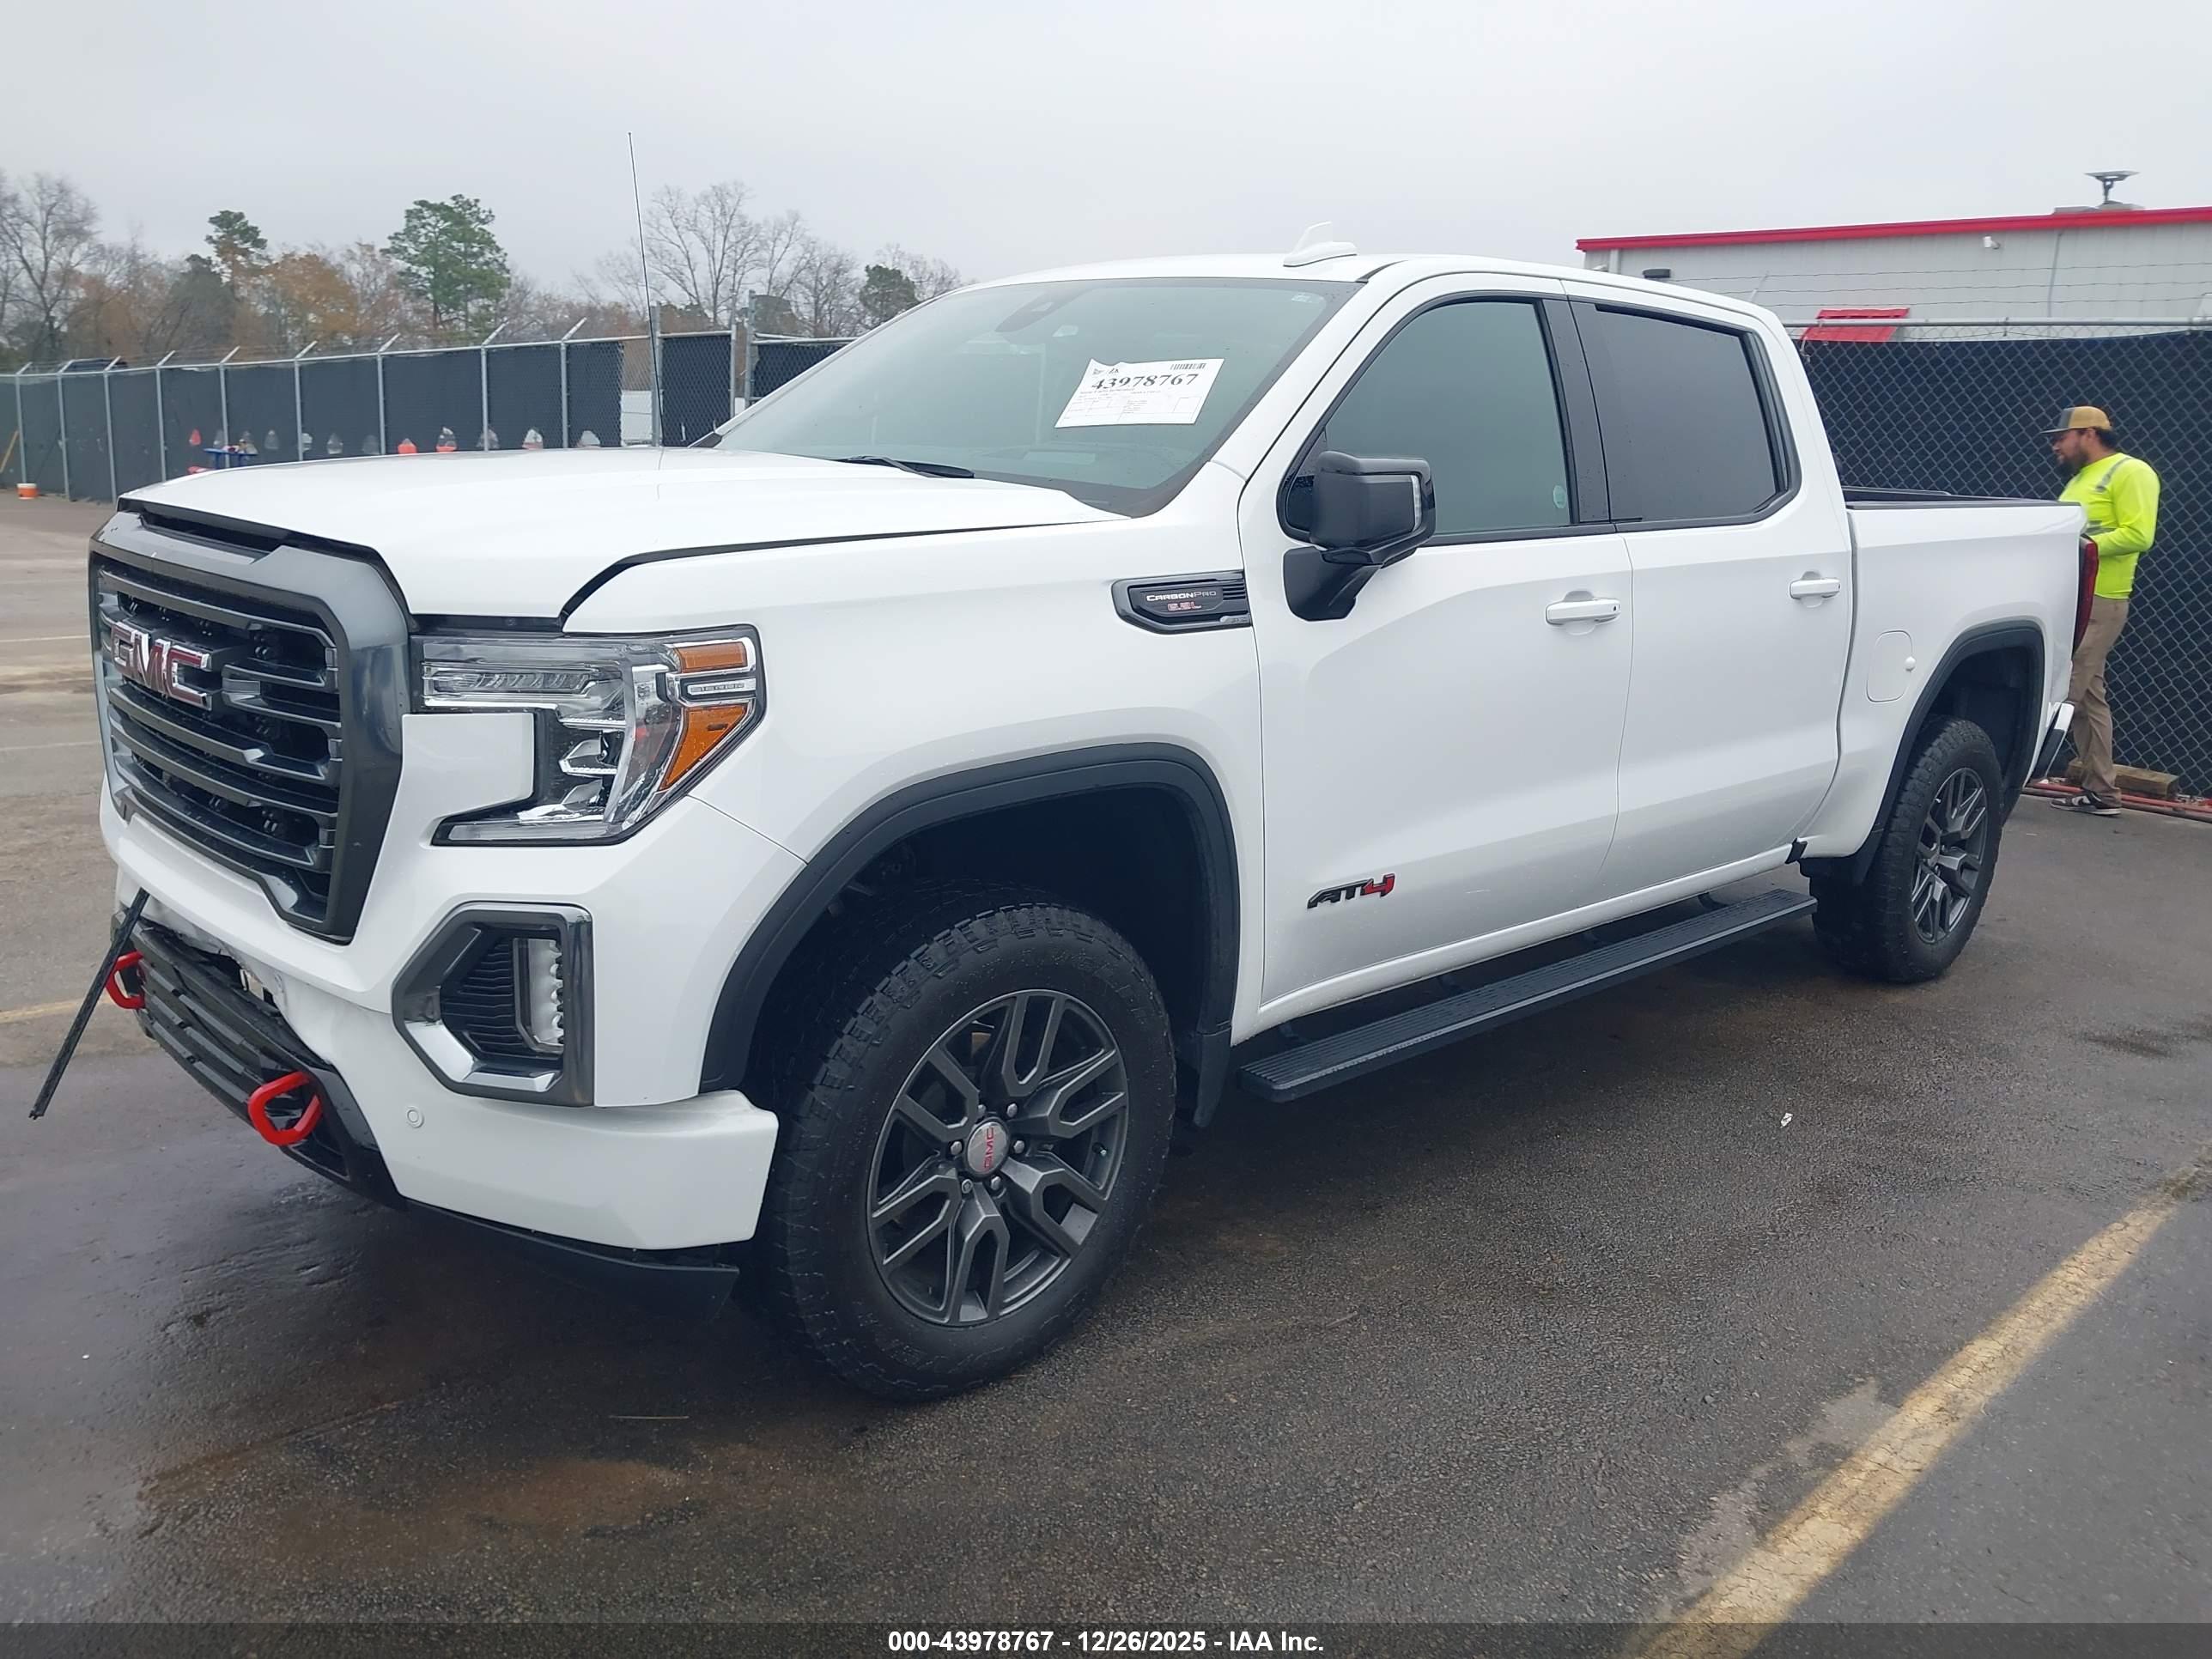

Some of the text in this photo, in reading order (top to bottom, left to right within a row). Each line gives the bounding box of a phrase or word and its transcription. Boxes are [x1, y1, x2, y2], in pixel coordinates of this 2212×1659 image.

[1092, 374, 1199, 389] 43978767
[111, 622, 212, 711] GMC
[1307, 873, 1395, 909] AT4
[983, 1126, 994, 1169] GMC
